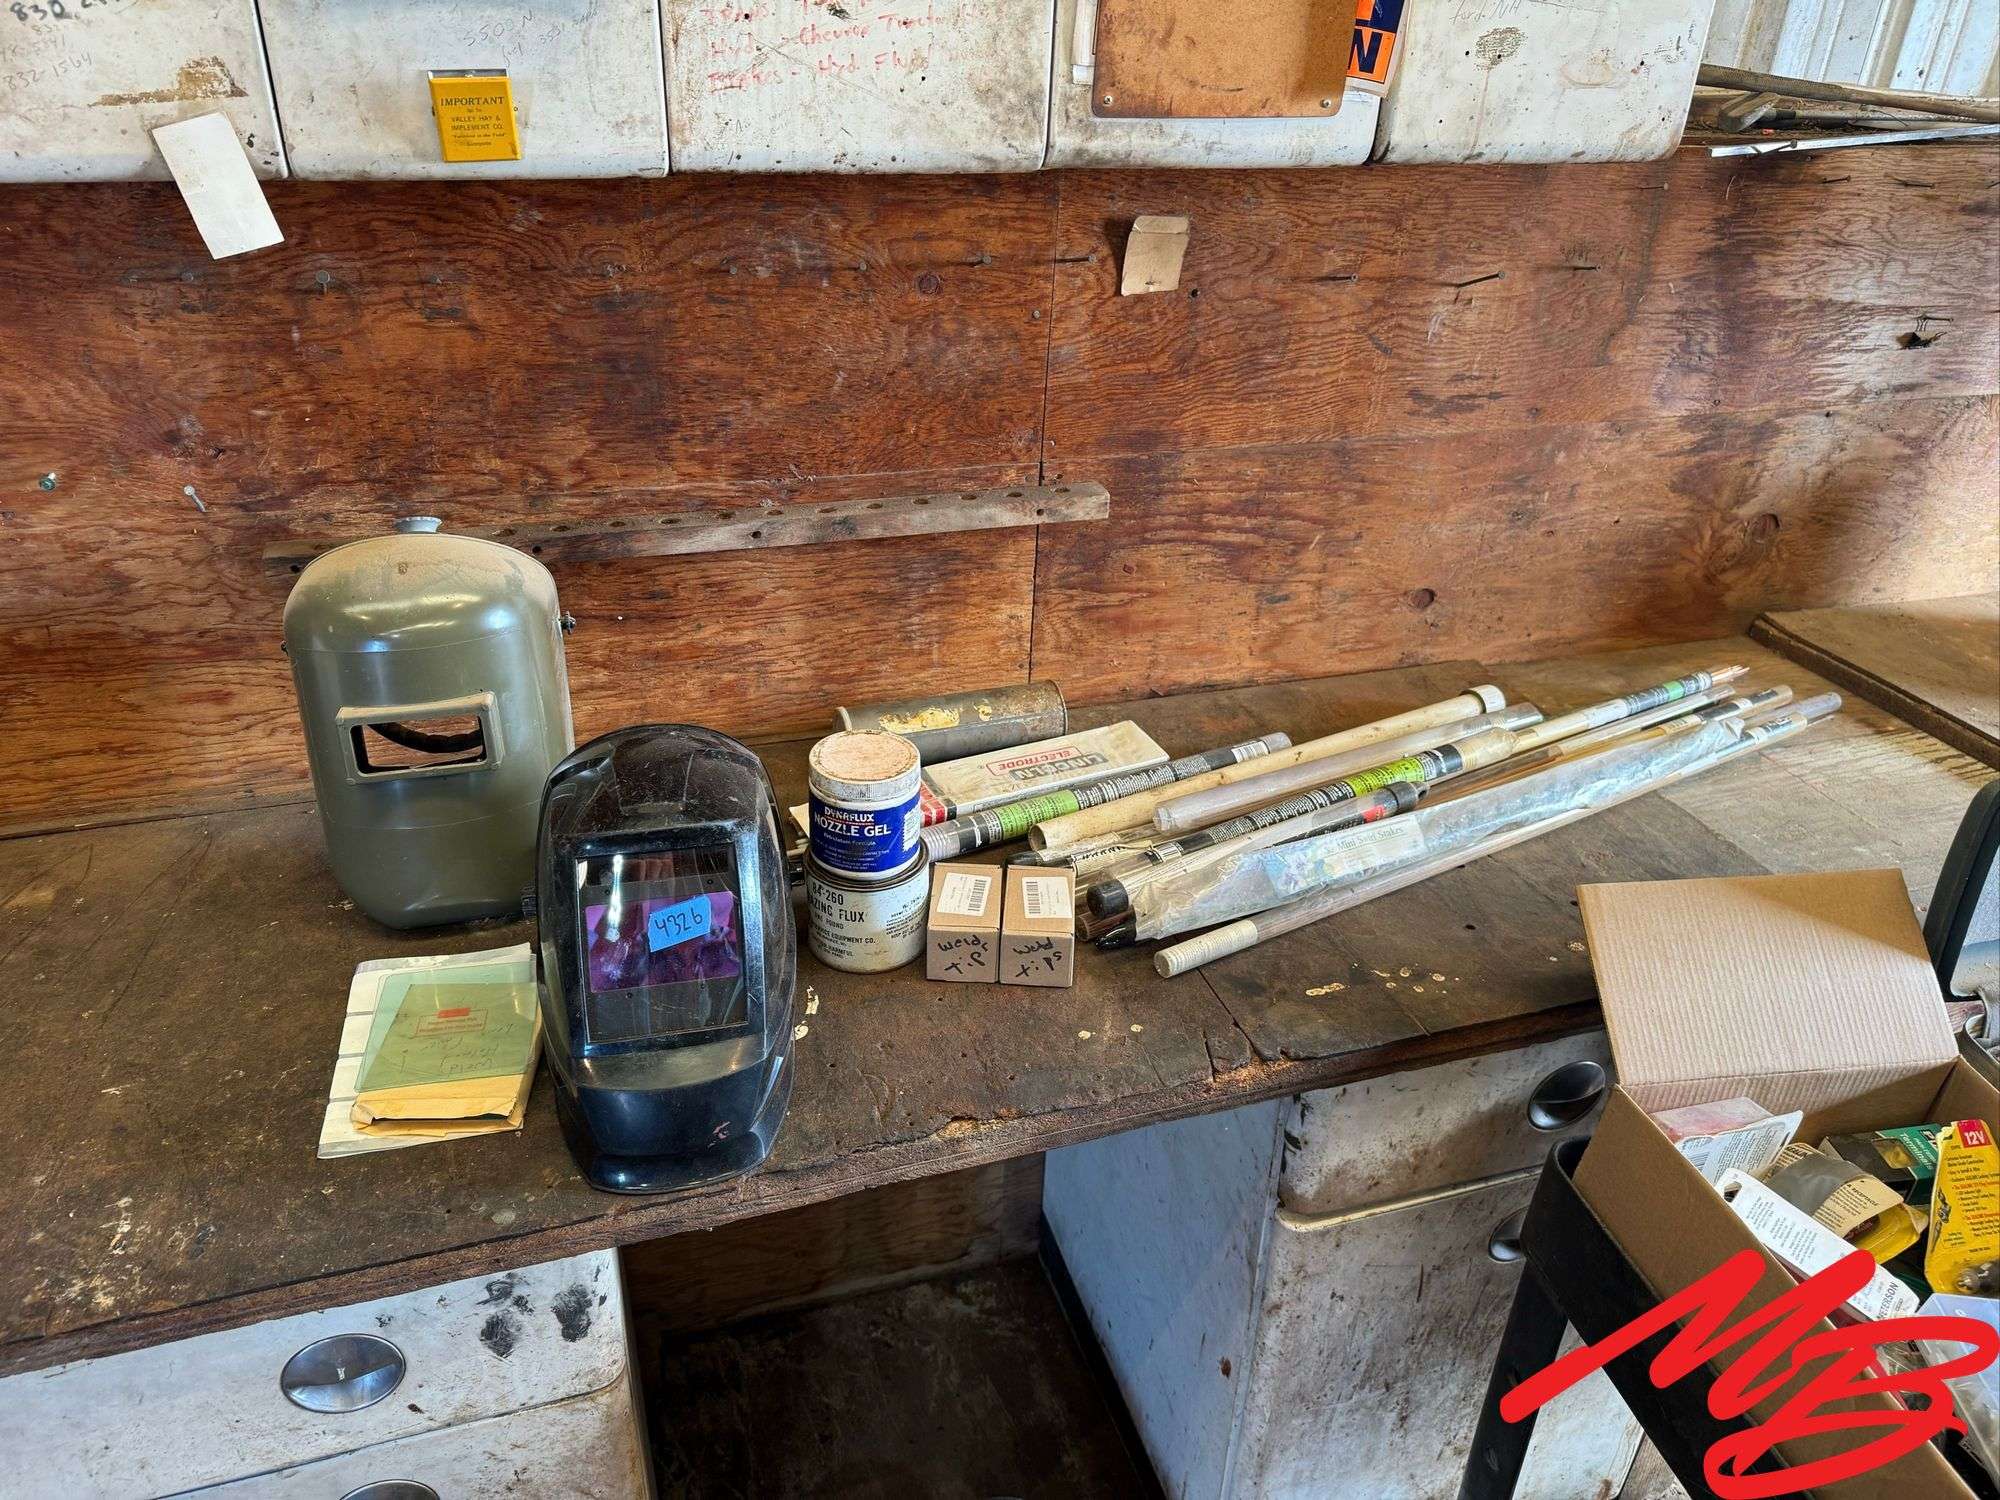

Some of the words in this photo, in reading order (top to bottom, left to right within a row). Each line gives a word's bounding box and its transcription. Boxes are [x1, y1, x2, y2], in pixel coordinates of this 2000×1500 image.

[440, 96, 504, 106] IMPORTANT
[997, 750, 1072, 770] ELECTRODE
[814, 811, 860, 837] NOZZLE
[864, 823, 892, 837] GEL
[838, 908, 865, 923] FLUX
[1963, 1130, 1985, 1146] 12V
[1900, 1132, 1934, 1170] Terminals
